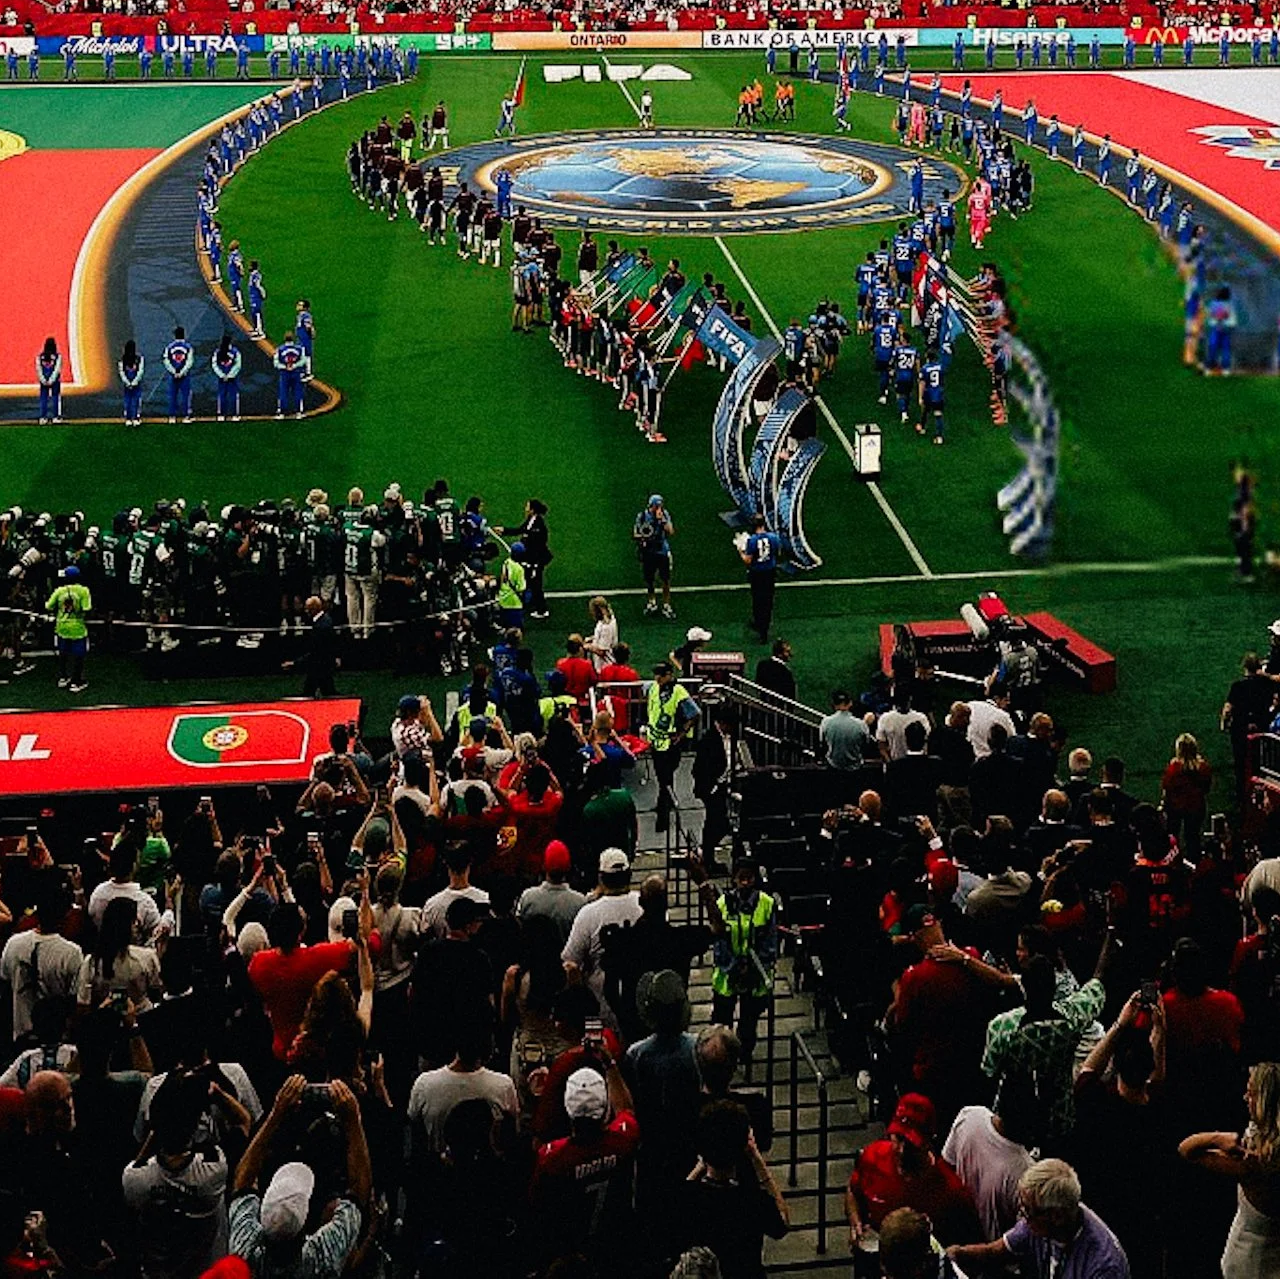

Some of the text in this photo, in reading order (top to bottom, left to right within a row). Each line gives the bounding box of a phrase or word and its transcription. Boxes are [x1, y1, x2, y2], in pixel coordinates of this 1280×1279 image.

[60, 35, 239, 55] Michelob ULTRA
[711, 34, 886, 47] BANK OF AMERIC
[972, 28, 1071, 45] Hisense
[587, 217, 714, 230] WORLD
[709, 318, 748, 360] FIFA
[929, 371, 940, 388] 9
